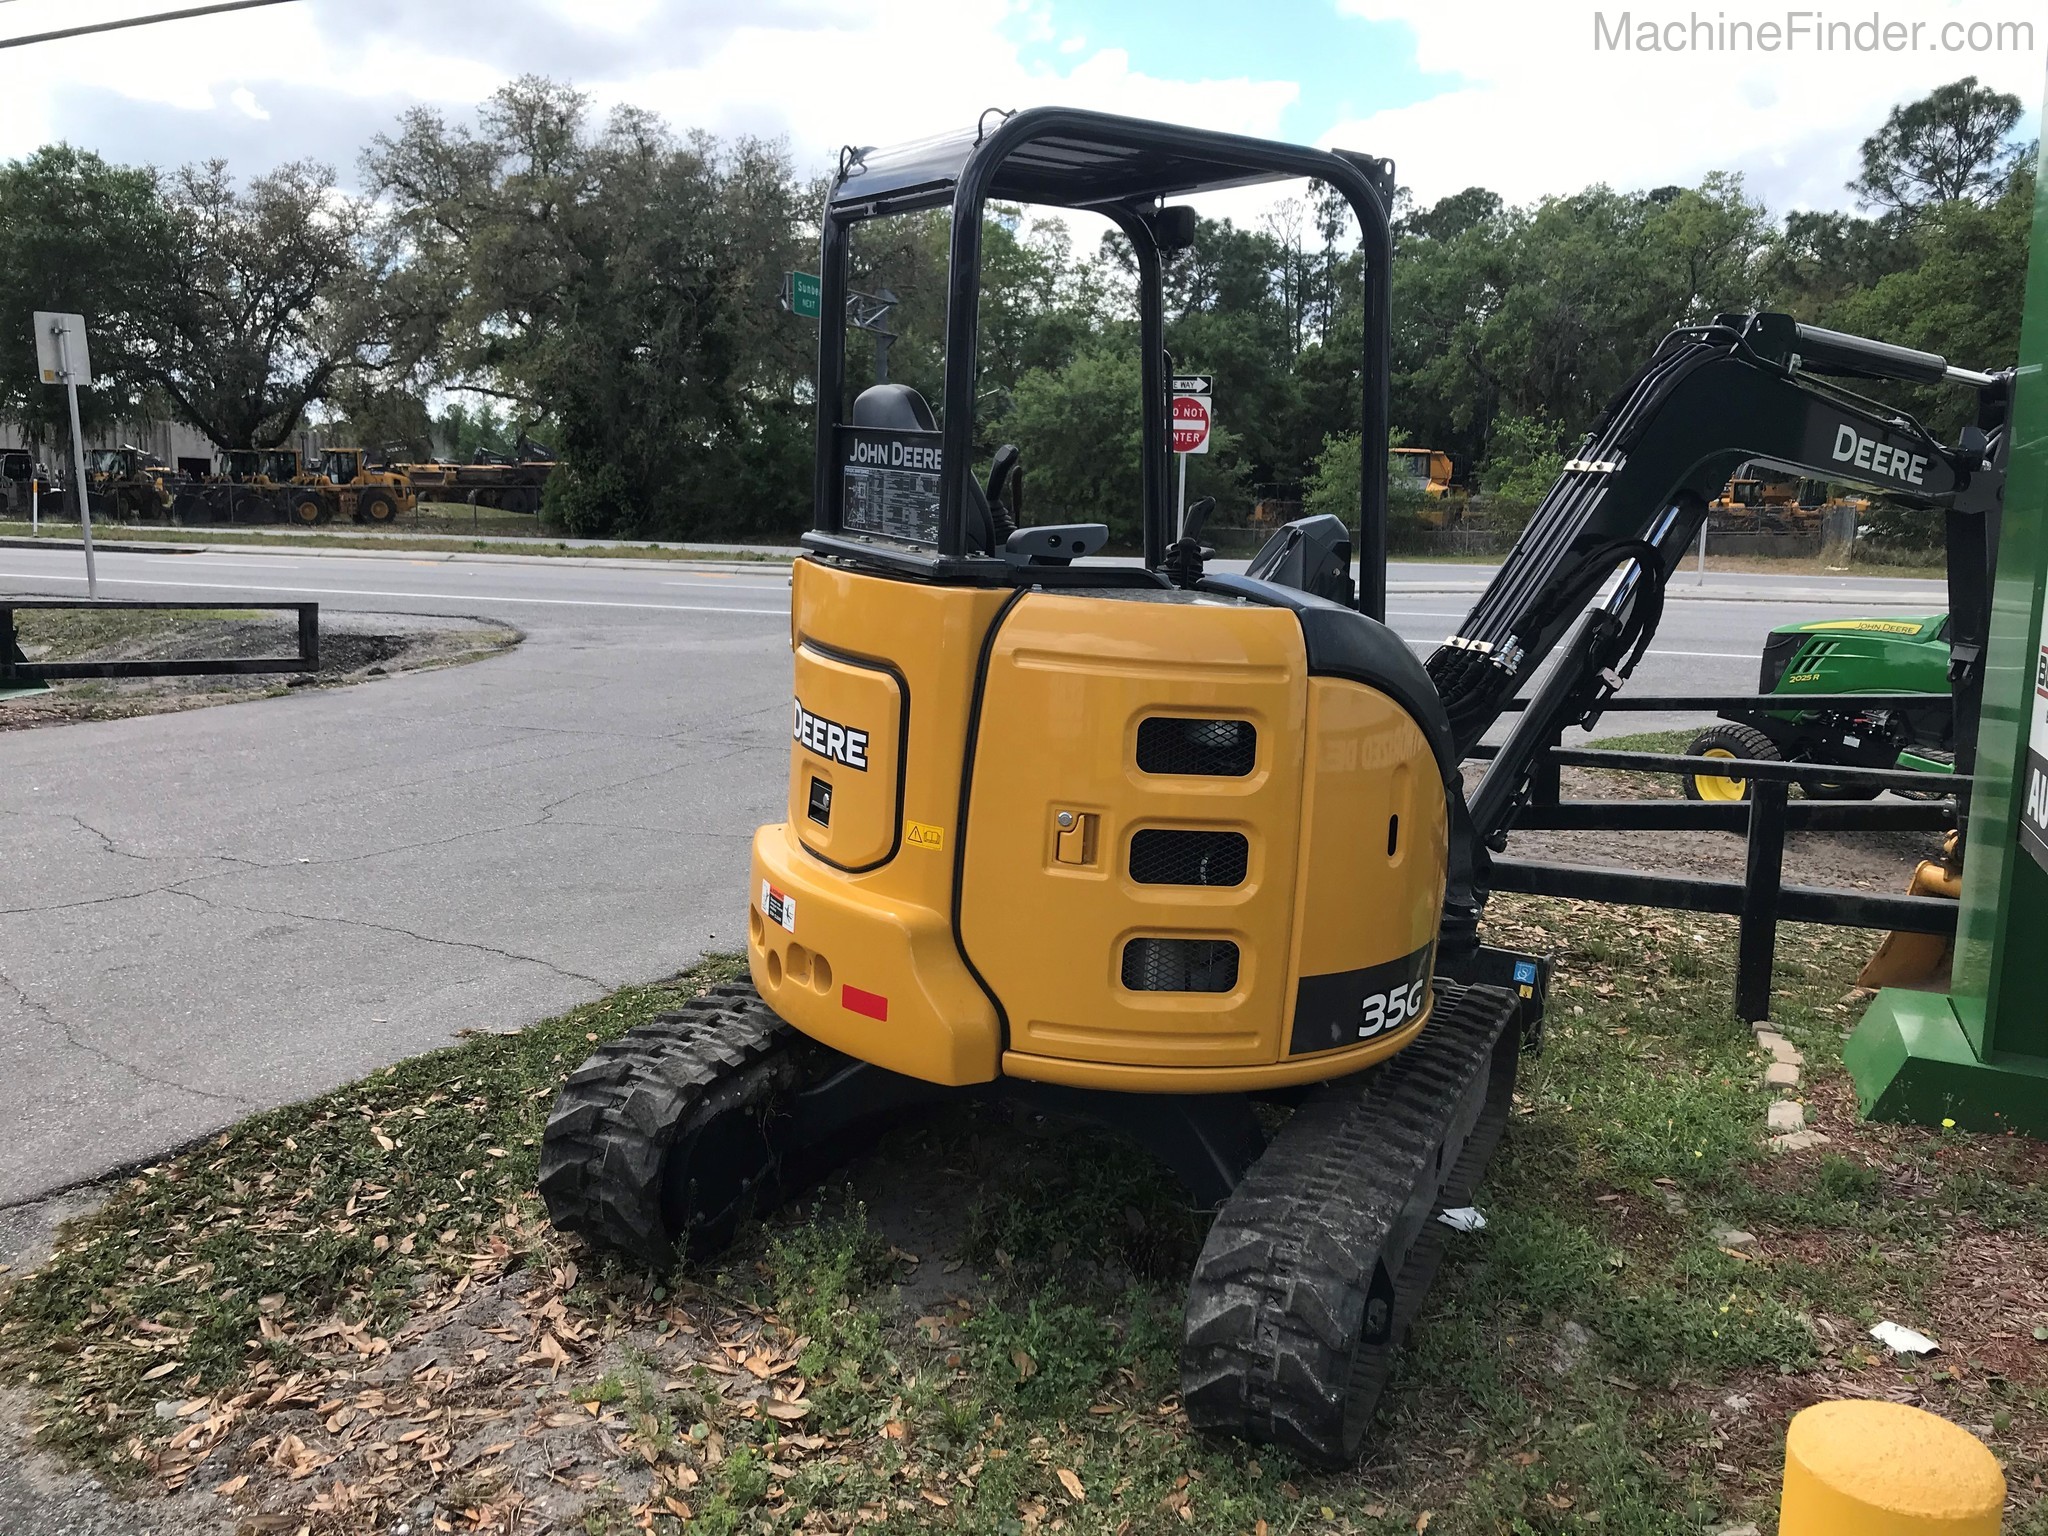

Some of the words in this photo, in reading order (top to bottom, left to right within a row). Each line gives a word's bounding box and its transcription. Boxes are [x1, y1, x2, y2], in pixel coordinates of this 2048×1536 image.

[797, 280, 821, 297] Sunbe
[1180, 381, 1196, 389] WAY
[1183, 408, 1204, 418] NOT
[1173, 432, 1200, 442] NTER
[849, 438, 888, 465] JOHN
[891, 441, 942, 470] DEERE
[1832, 424, 1928, 485] DEERE
[1854, 622, 1881, 631] JOHN
[1882, 623, 1915, 634] DEERE
[793, 697, 868, 770] DEERE
[1358, 979, 1424, 1038] 35G
